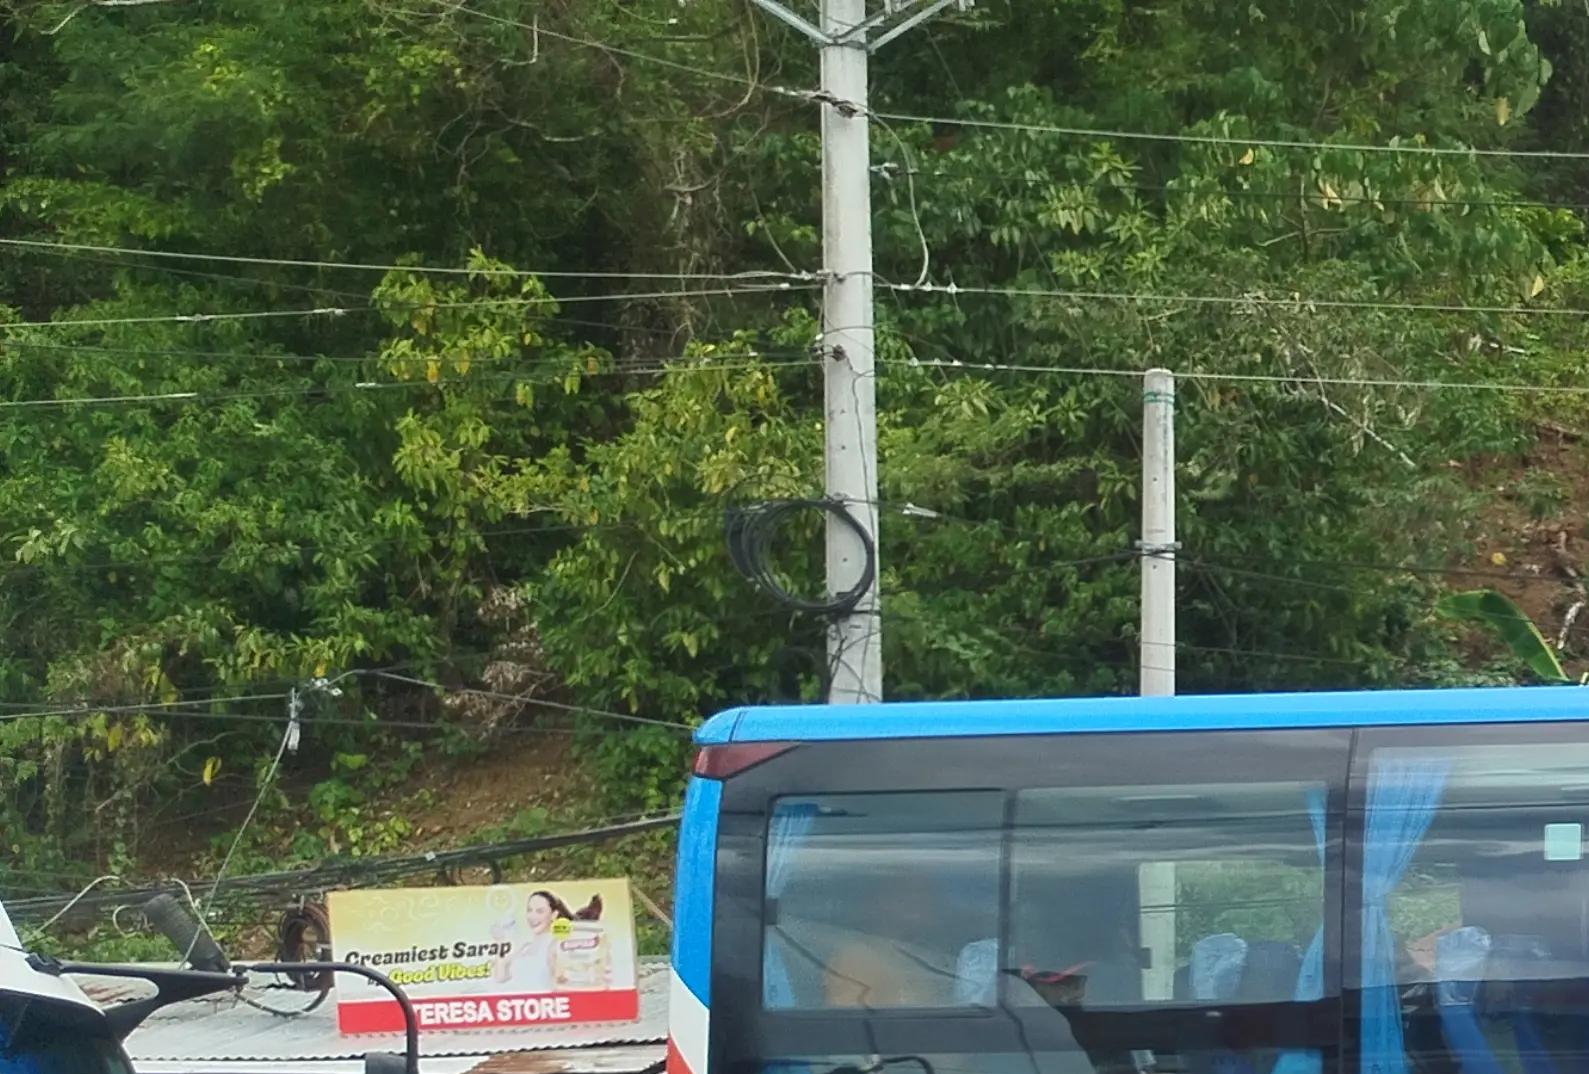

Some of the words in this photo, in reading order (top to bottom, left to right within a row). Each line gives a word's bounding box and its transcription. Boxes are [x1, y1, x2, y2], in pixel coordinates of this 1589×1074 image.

[345, 944, 449, 967] Creamiest
[452, 940, 512, 960] Sarap
[388, 963, 434, 985] Good
[436, 962, 492, 982] Vibes!
[497, 996, 571, 1021] STORE
